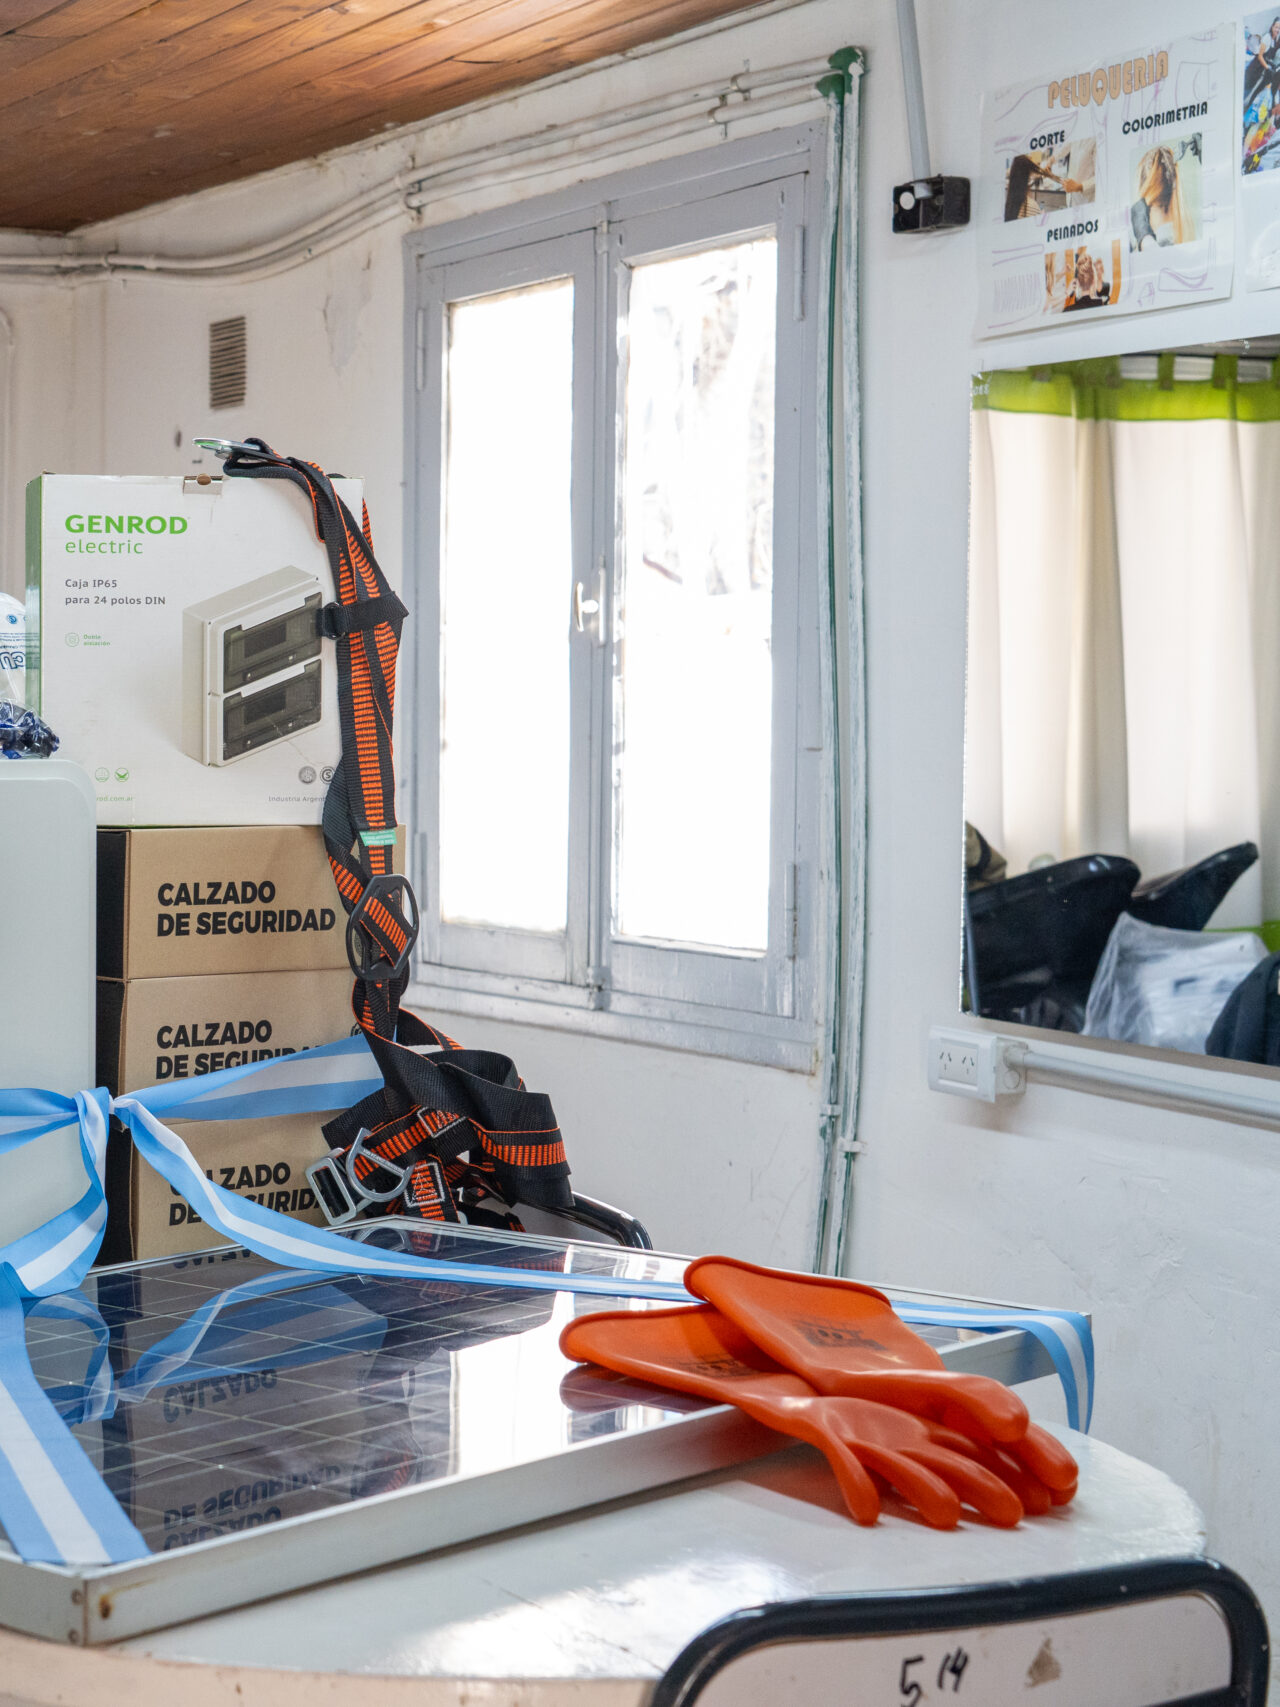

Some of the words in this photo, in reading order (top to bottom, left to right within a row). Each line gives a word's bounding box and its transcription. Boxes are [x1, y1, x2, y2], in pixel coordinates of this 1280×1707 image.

[1048, 50, 1169, 109] PELUQUERIA
[1122, 101, 1208, 136] COLORIMETRIA
[1030, 130, 1065, 151] CORTE
[1047, 219, 1099, 242] PEINADOS
[64, 514, 188, 535] GENROD
[65, 539, 144, 555] electric
[65, 579, 89, 590] Caja
[92, 579, 118, 588] IP65
[65, 597, 90, 605] para
[94, 596, 107, 604] 24
[111, 596, 142, 606] polos
[145, 596, 166, 605] DIN
[157, 881, 276, 907] CALZADO
[157, 912, 190, 937] DE
[195, 908, 336, 937] SEGURIDAD
[156, 1020, 272, 1050] CALZADO
[156, 1054, 189, 1079] DE
[900, 1653, 924, 1707] 5
